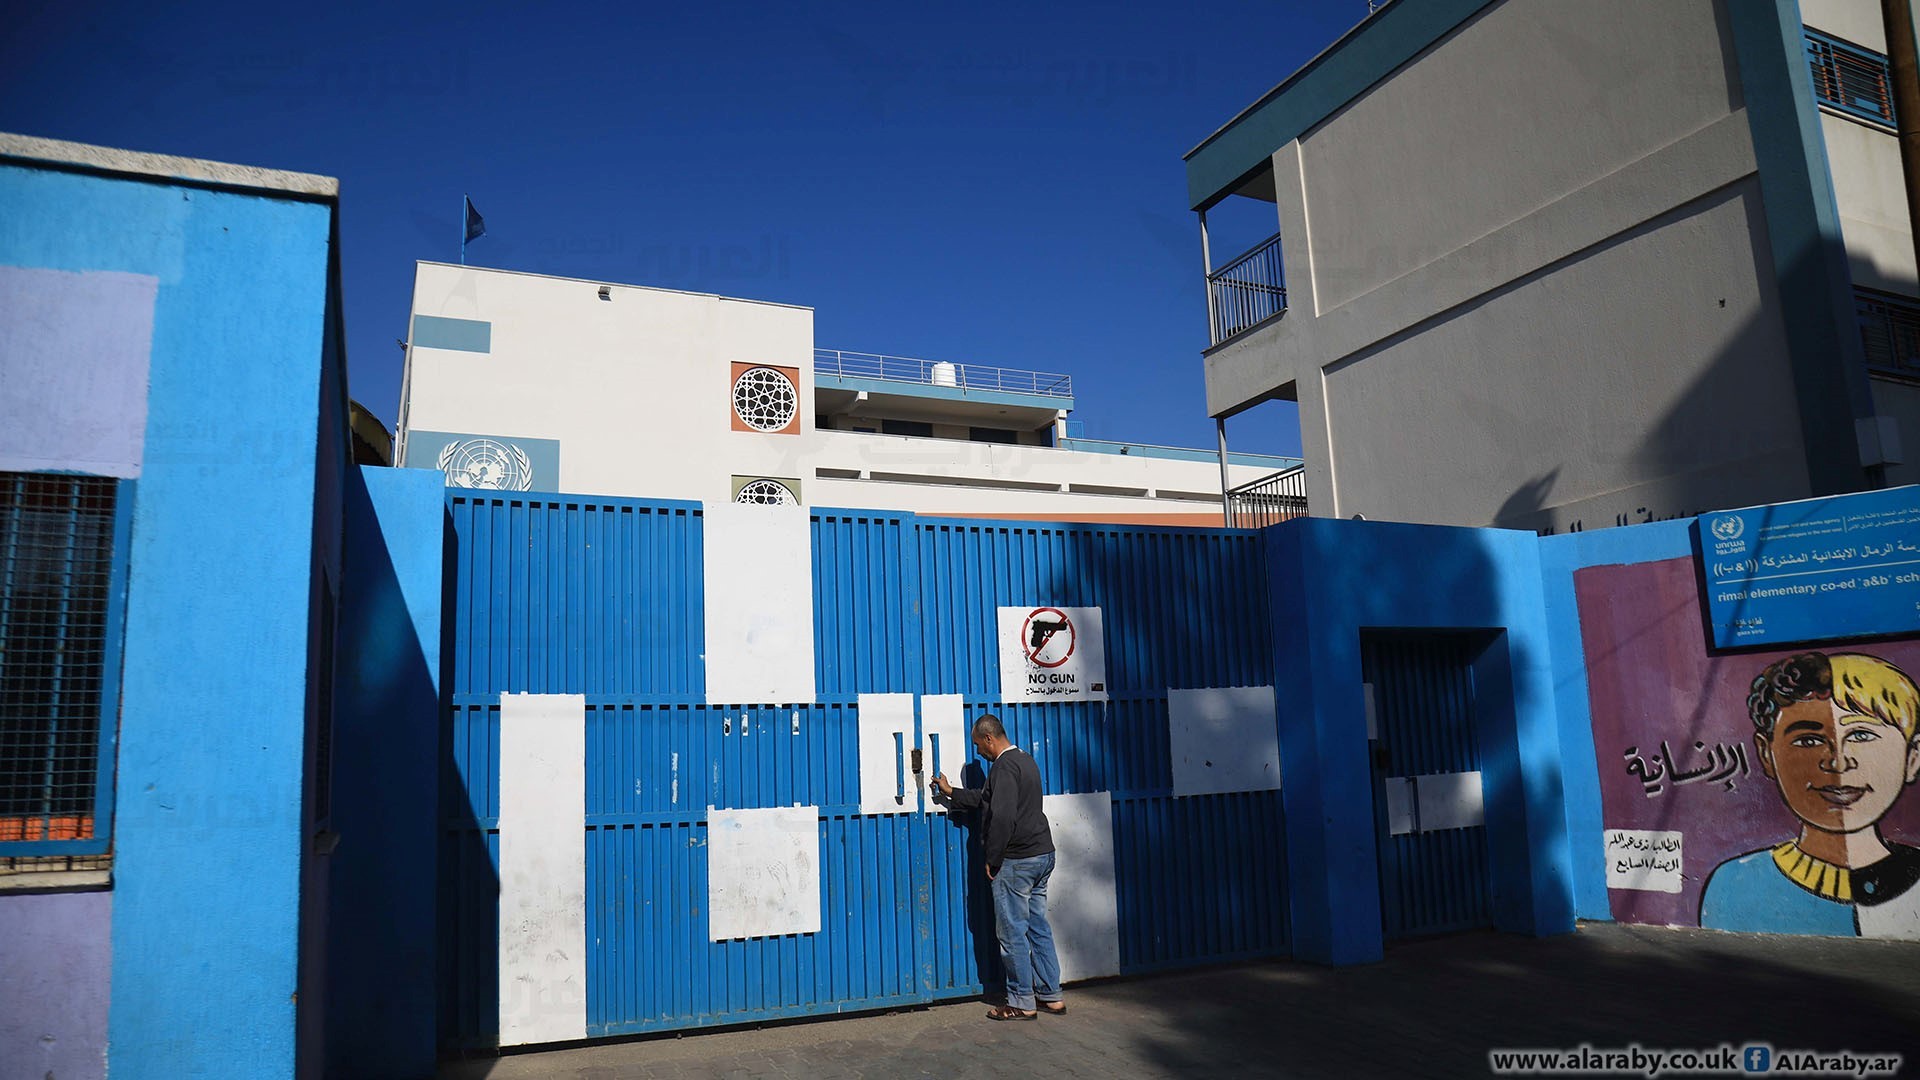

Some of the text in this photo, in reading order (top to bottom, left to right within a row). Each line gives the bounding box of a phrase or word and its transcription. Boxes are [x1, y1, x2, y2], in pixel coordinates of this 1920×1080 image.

[1714, 540, 1745, 549] unrwa
[1861, 543, 1894, 558] الرمال
[1762, 553, 1809, 569] المشتركة
[1718, 590, 1748, 602] rimal
[1750, 584, 1817, 599] elementary
[1820, 578, 1856, 591] co-ed
[1028, 673, 1075, 684] NO GUN
[1025, 687, 1046, 696] بالسلاح
[1046, 686, 1064, 696] الدخول
[1623, 740, 1751, 798] الإنسانية
